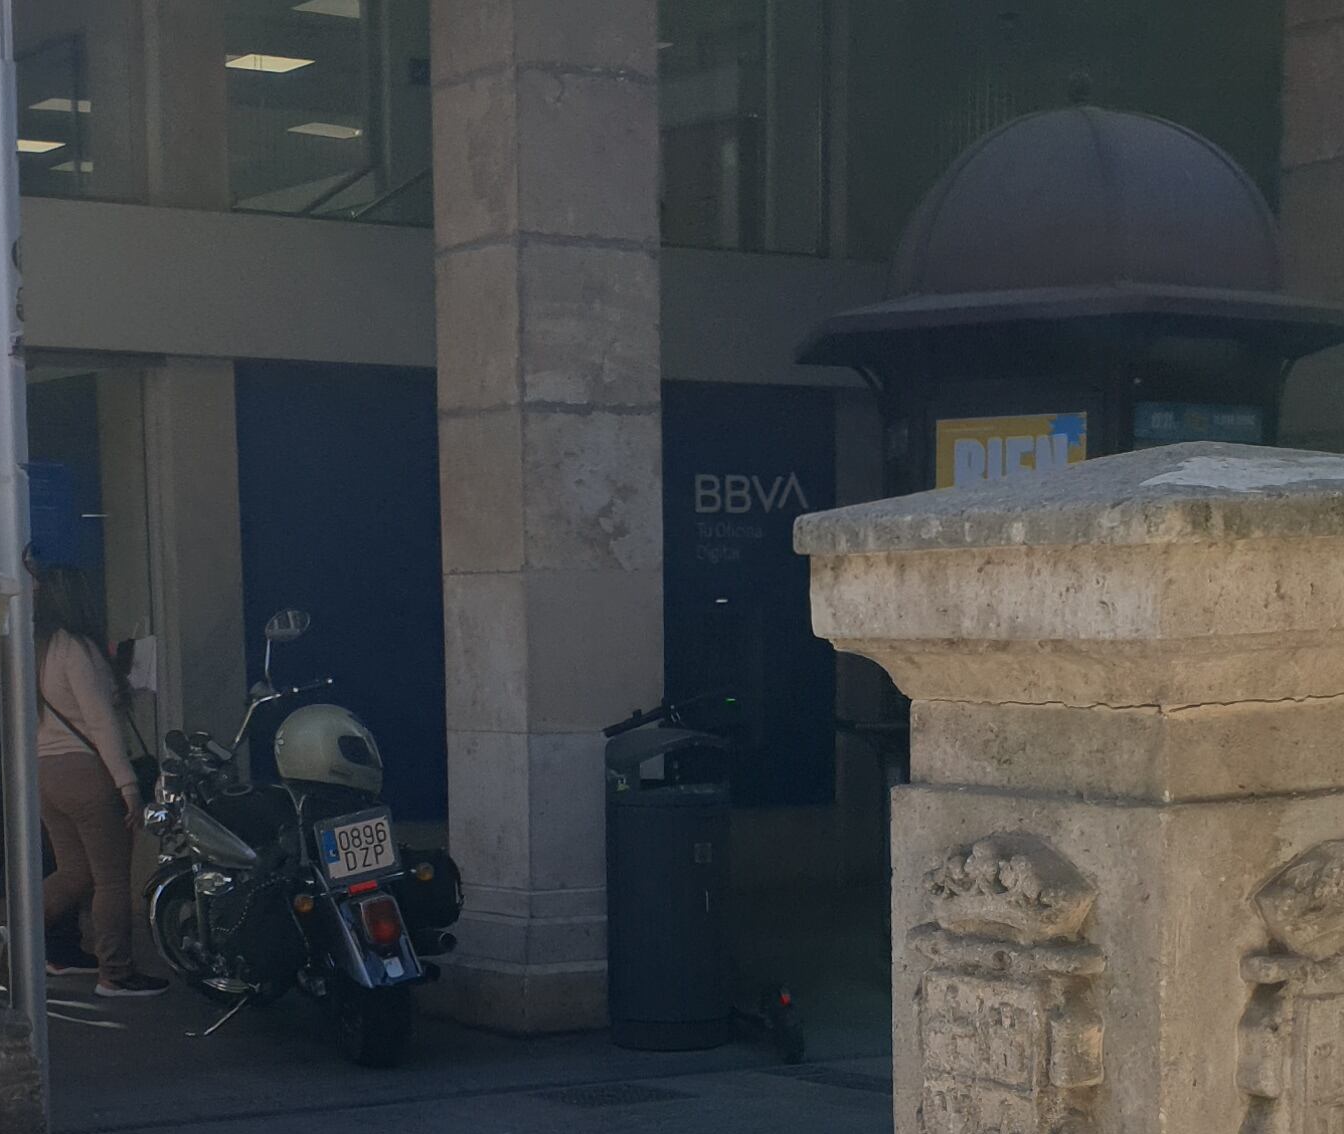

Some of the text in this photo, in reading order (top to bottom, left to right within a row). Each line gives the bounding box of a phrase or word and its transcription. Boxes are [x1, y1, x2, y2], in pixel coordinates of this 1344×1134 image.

[695, 472, 809, 513] BBVA
[338, 822, 387, 851] 0896
[345, 844, 385, 871] DZP
